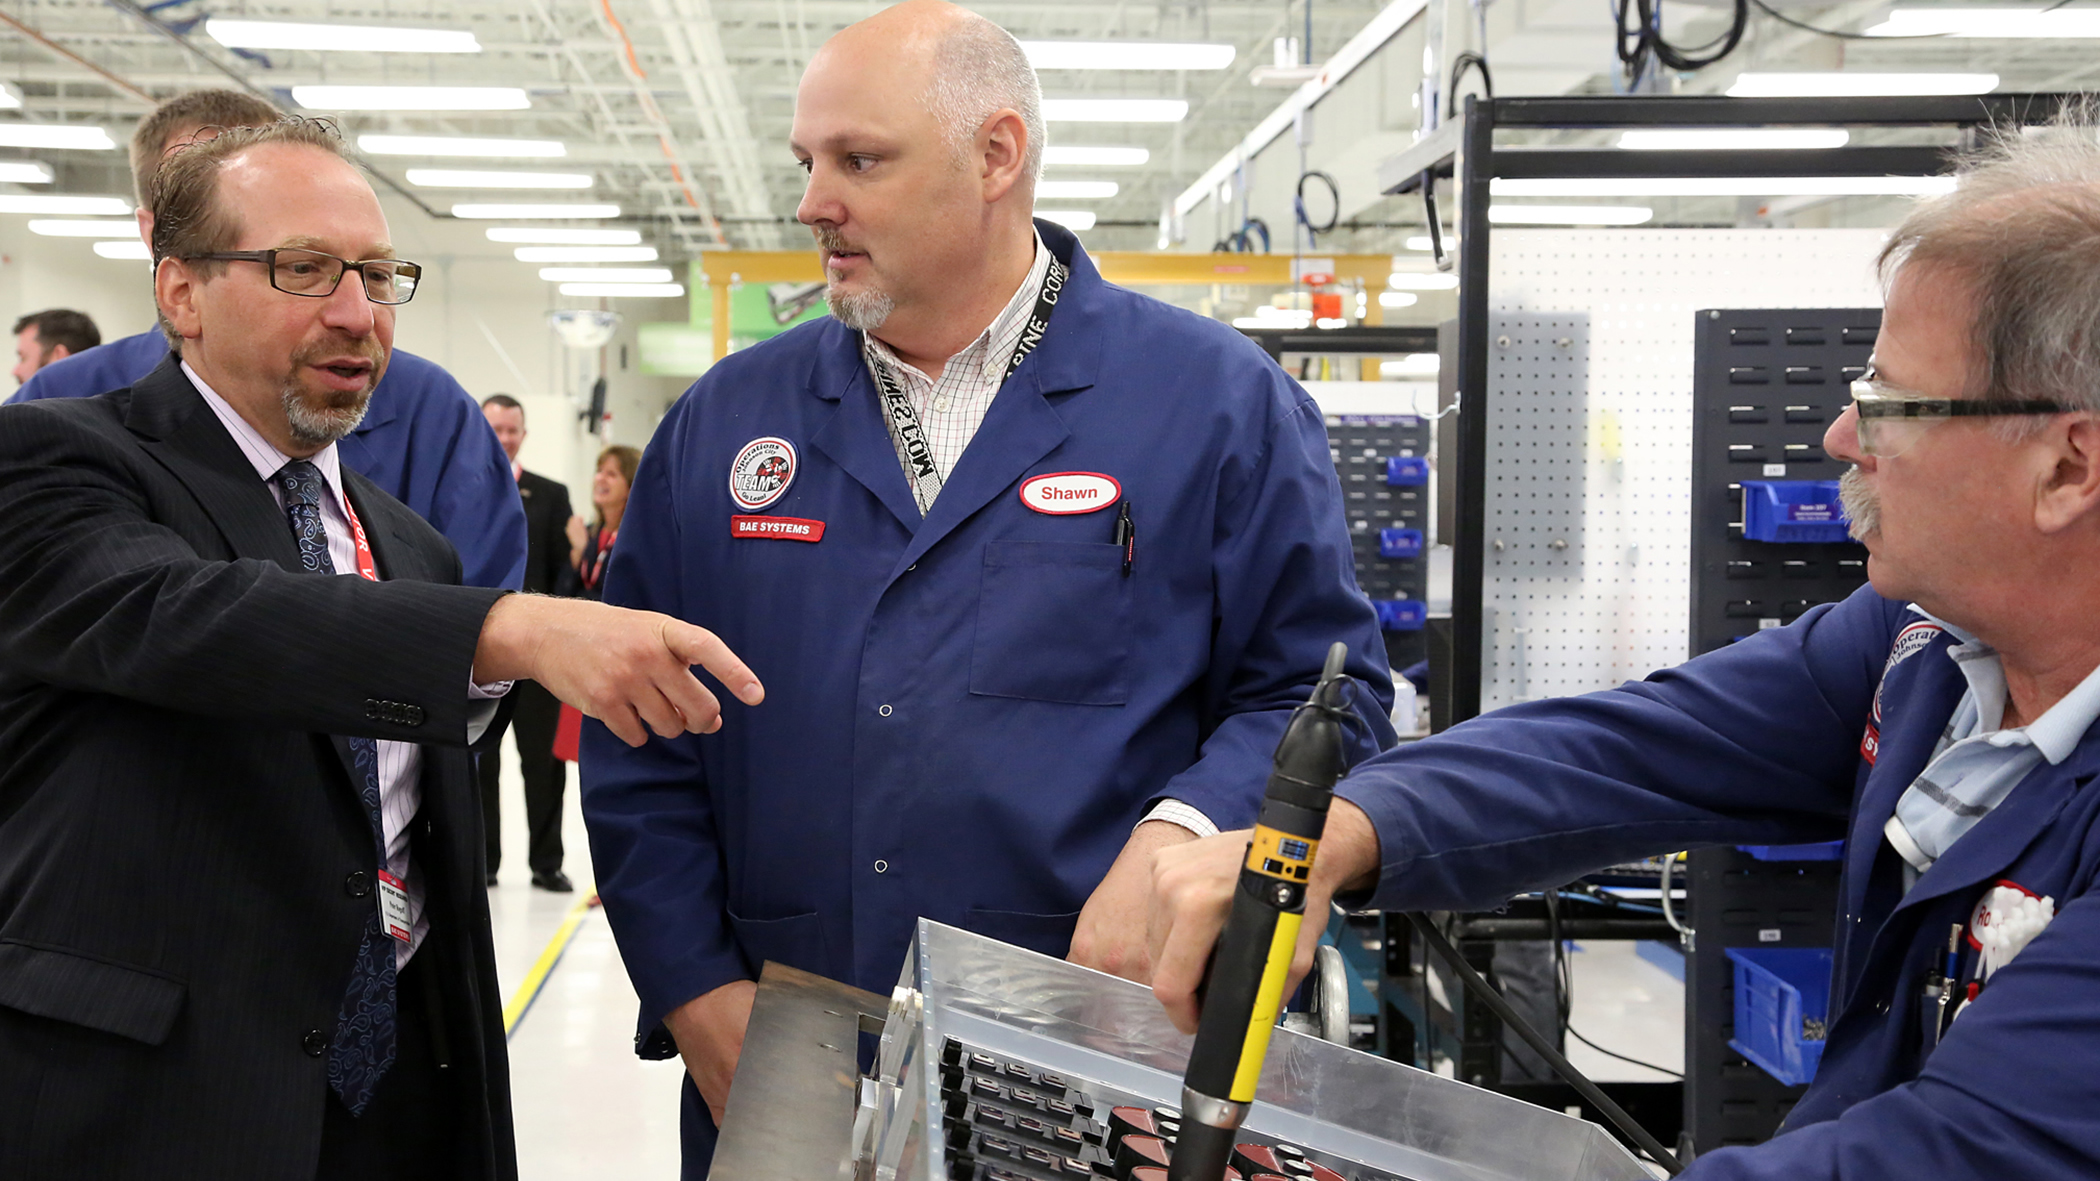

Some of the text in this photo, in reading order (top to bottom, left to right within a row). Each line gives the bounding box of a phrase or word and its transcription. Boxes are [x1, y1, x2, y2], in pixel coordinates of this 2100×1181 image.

[736, 443, 780, 473] Operations
[735, 474, 771, 491] TEAM
[741, 491, 749, 500] Go
[1041, 486, 1098, 500] Shawn
[739, 522, 810, 534] BAE SYSTEMS
[1977, 905, 1991, 926] Ro
